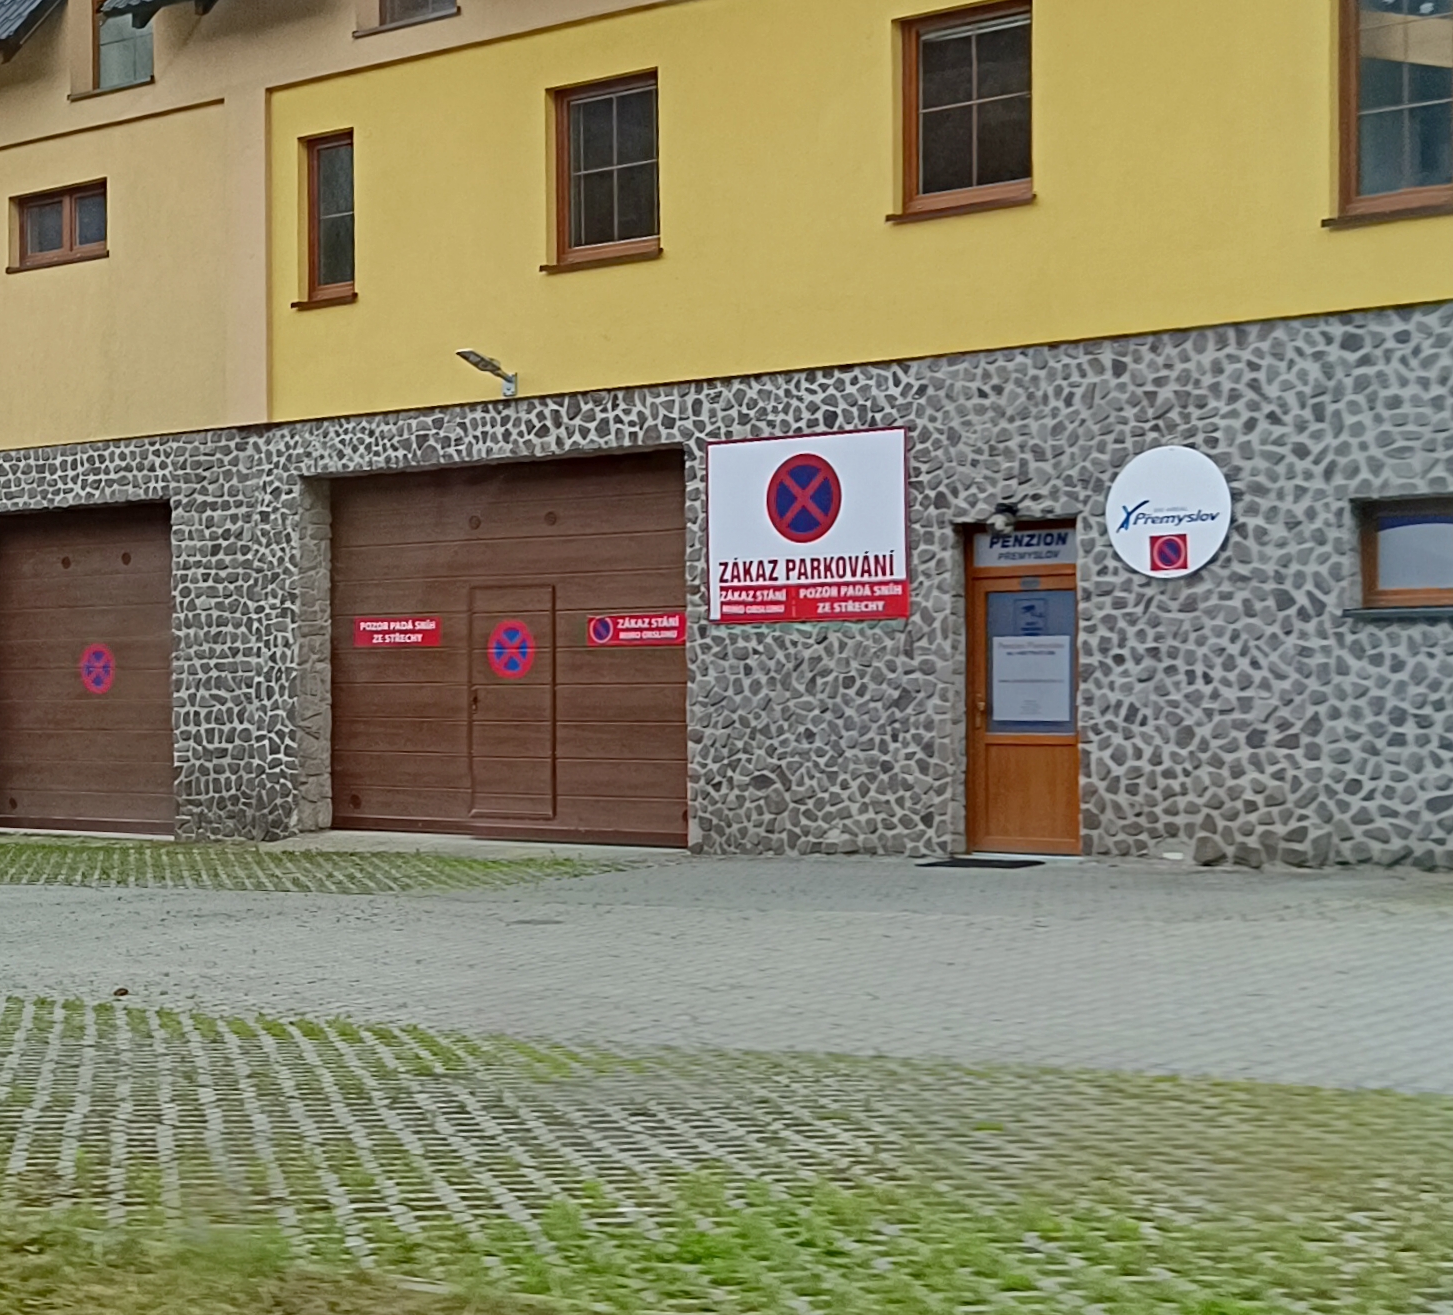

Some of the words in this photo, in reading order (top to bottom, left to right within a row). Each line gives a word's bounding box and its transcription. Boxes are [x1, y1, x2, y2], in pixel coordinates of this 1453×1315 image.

[989, 532, 1069, 549] PENZION
[719, 557, 778, 584] ZÁKAZ
[785, 550, 895, 582] PARKOVÁNÍ
[720, 589, 755, 603] ZÁKAZ
[756, 588, 787, 602] STÁNÍ
[799, 587, 838, 599] POZOR
[840, 584, 870, 598] PADÁ
[817, 602, 832, 614] ZE
[616, 617, 650, 629] ZÁKAZ
